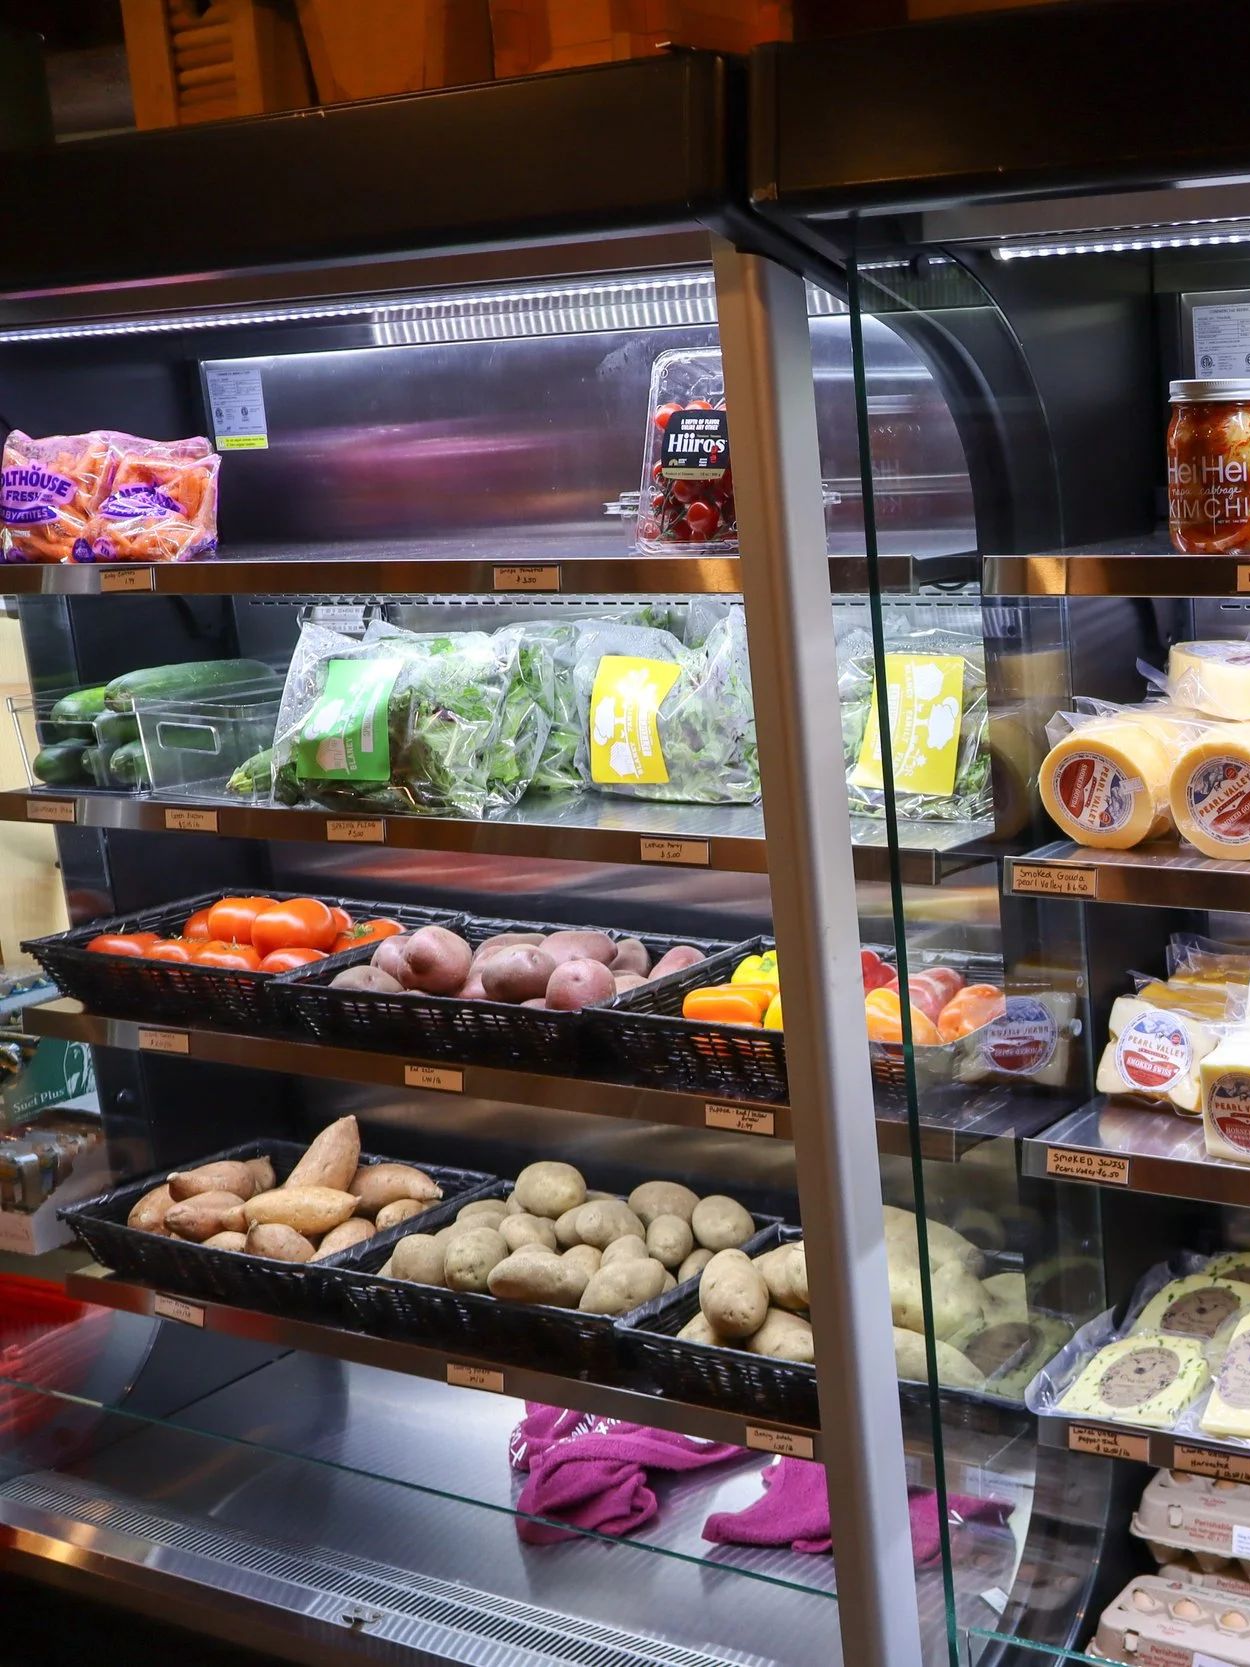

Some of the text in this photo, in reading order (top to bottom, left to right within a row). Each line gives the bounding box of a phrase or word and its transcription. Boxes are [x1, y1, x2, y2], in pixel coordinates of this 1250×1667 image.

[668, 433, 726, 453] Hiiros
[1201, 454, 1247, 484] Hei
[0, 468, 72, 497] OLTHOUSE
[1200, 486, 1242, 499] cabbage
[6, 490, 41, 502] FRESH
[1169, 497, 1249, 519] KIMCHI
[1088, 766, 1110, 825] PEARL VALLEY
[1199, 796, 1225, 817] PEARL
[1020, 868, 1084, 882] Smoked Gouda
[1128, 1034, 1185, 1058] PEARL VALLEY
[40, 1089, 65, 1104] Plus
[1215, 1102, 1243, 1112] PEARL
[1053, 1153, 1126, 1170] SMOKED SWISS
